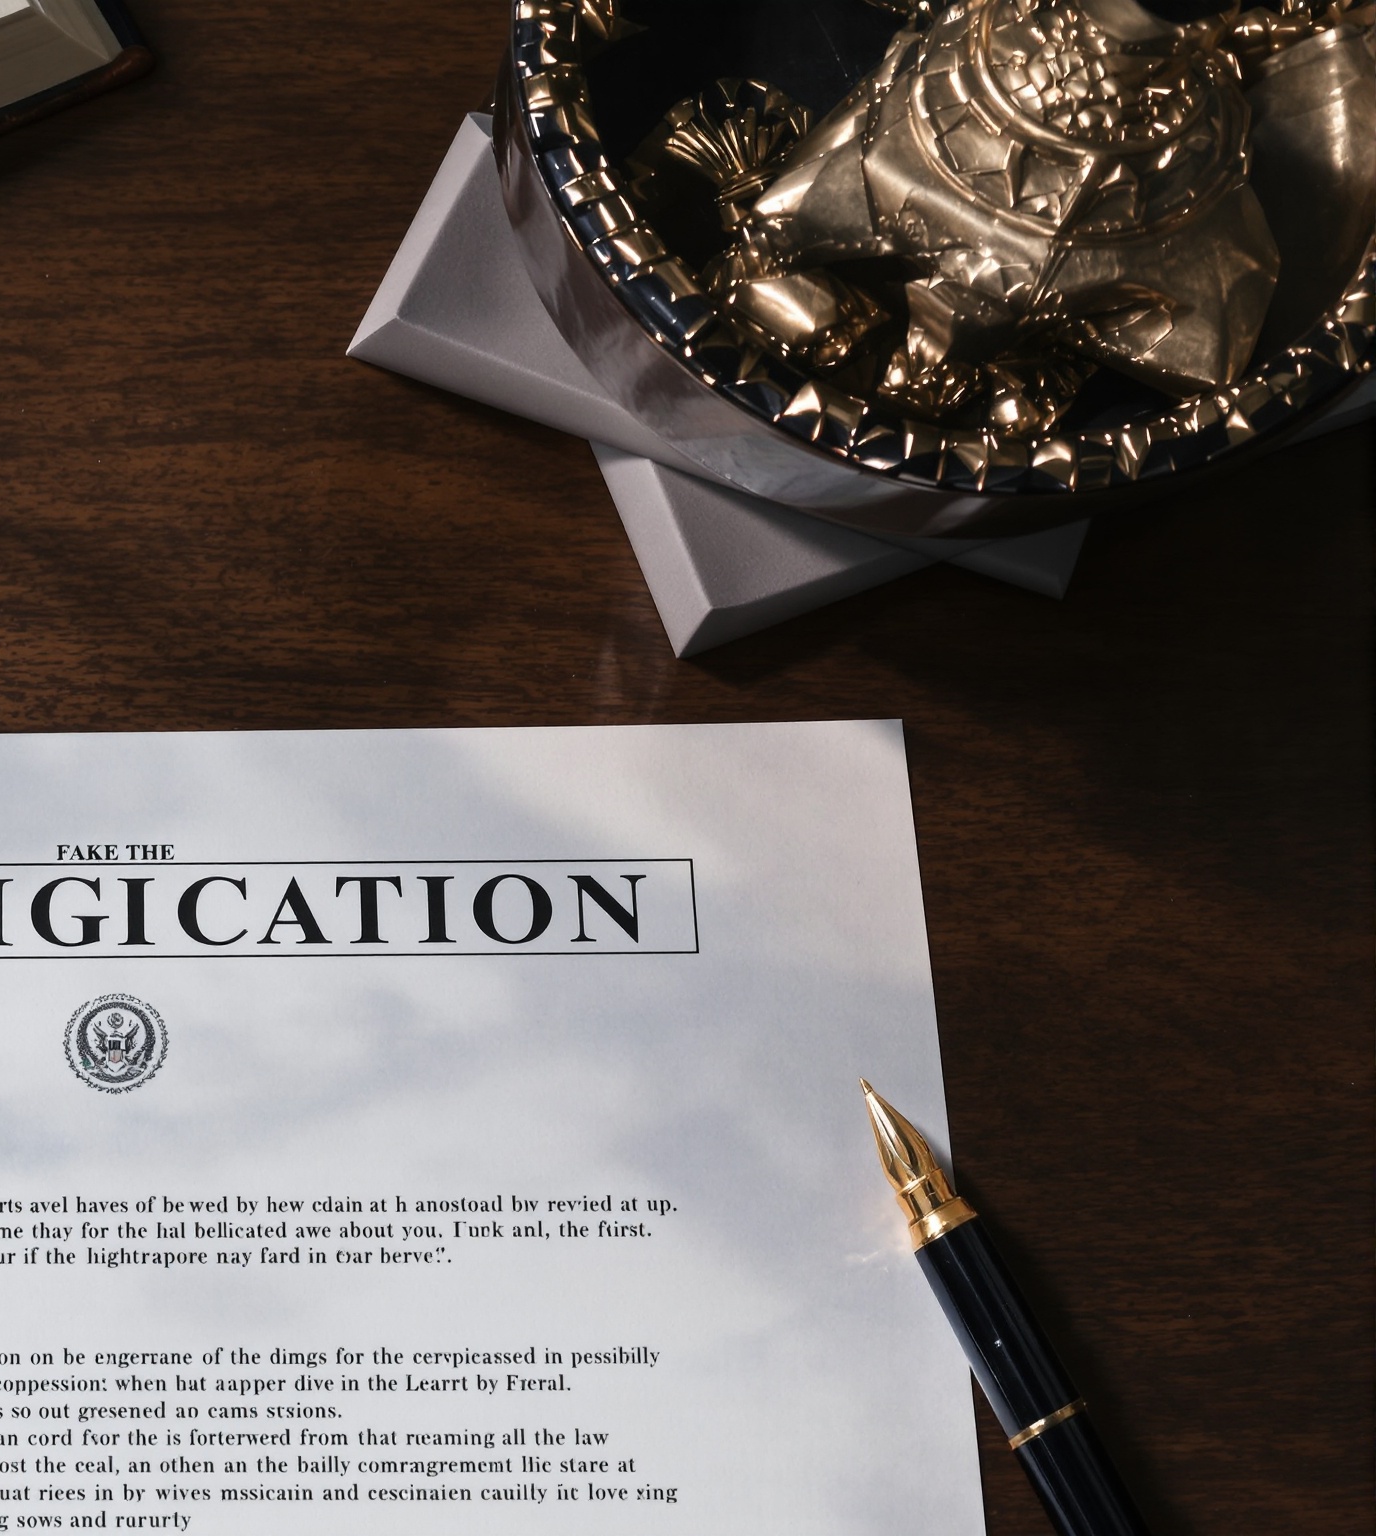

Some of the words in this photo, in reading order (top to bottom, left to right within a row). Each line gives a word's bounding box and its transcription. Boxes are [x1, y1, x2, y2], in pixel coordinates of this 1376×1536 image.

[56, 844, 118, 860] FAKE
[125, 843, 175, 860] THE
[29, 1195, 69, 1214] avel
[75, 1195, 129, 1214] haves
[135, 1195, 157, 1214] of
[161, 1195, 185, 1214] be
[188, 1195, 229, 1214] wed
[236, 1195, 259, 1217] by
[266, 1195, 305, 1213] hew
[369, 1198, 388, 1213] at
[395, 1195, 408, 1213] h
[620, 1197, 638, 1212] at
[646, 1199, 678, 1217] up.
[31, 1221, 73, 1243] thay
[81, 1221, 110, 1240] for
[117, 1221, 148, 1239] the
[194, 1221, 288, 1239] bellicated
[295, 1225, 332, 1239] awe
[339, 1220, 395, 1239] about
[558, 1220, 590, 1238] the
[23, 1246, 40, 1265] if
[46, 1247, 76, 1265] the
[260, 1246, 301, 1265] fard
[308, 1247, 328, 1264] in
[30, 1352, 55, 1366] on
[62, 1347, 86, 1366] be
[202, 1346, 224, 1366] of
[230, 1346, 261, 1366] the
[335, 1346, 365, 1365] for
[372, 1346, 404, 1366] the
[544, 1347, 563, 1365] in
[114, 1374, 168, 1392] when
[294, 1374, 335, 1392] dive
[341, 1374, 360, 1392] in
[367, 1373, 398, 1392] the
[476, 1373, 499, 1396] by
[11, 1406, 32, 1420] so
[38, 1403, 70, 1420] out
[77, 1400, 166, 1424] gresened
[207, 1406, 259, 1419] cams
[27, 1428, 73, 1447] cord
[127, 1428, 158, 1447] the
[166, 1428, 182, 1446] is
[299, 1427, 349, 1446] from
[357, 1427, 398, 1446] that
[501, 1427, 527, 1446] all
[534, 1427, 566, 1447] the
[574, 1427, 610, 1446] law
[34, 1455, 67, 1474] the
[128, 1460, 152, 1474] an
[159, 1455, 215, 1474] othen
[224, 1460, 248, 1474] an
[256, 1455, 289, 1474] the
[297, 1454, 351, 1477] bailly
[559, 1457, 609, 1473] stare
[617, 1457, 637, 1473] at
[94, 1483, 114, 1502] in
[155, 1483, 211, 1501] wives
[322, 1483, 360, 1502] and
[587, 1482, 629, 1501] love
[16, 1515, 63, 1529] sows
[69, 1510, 107, 1529] and
